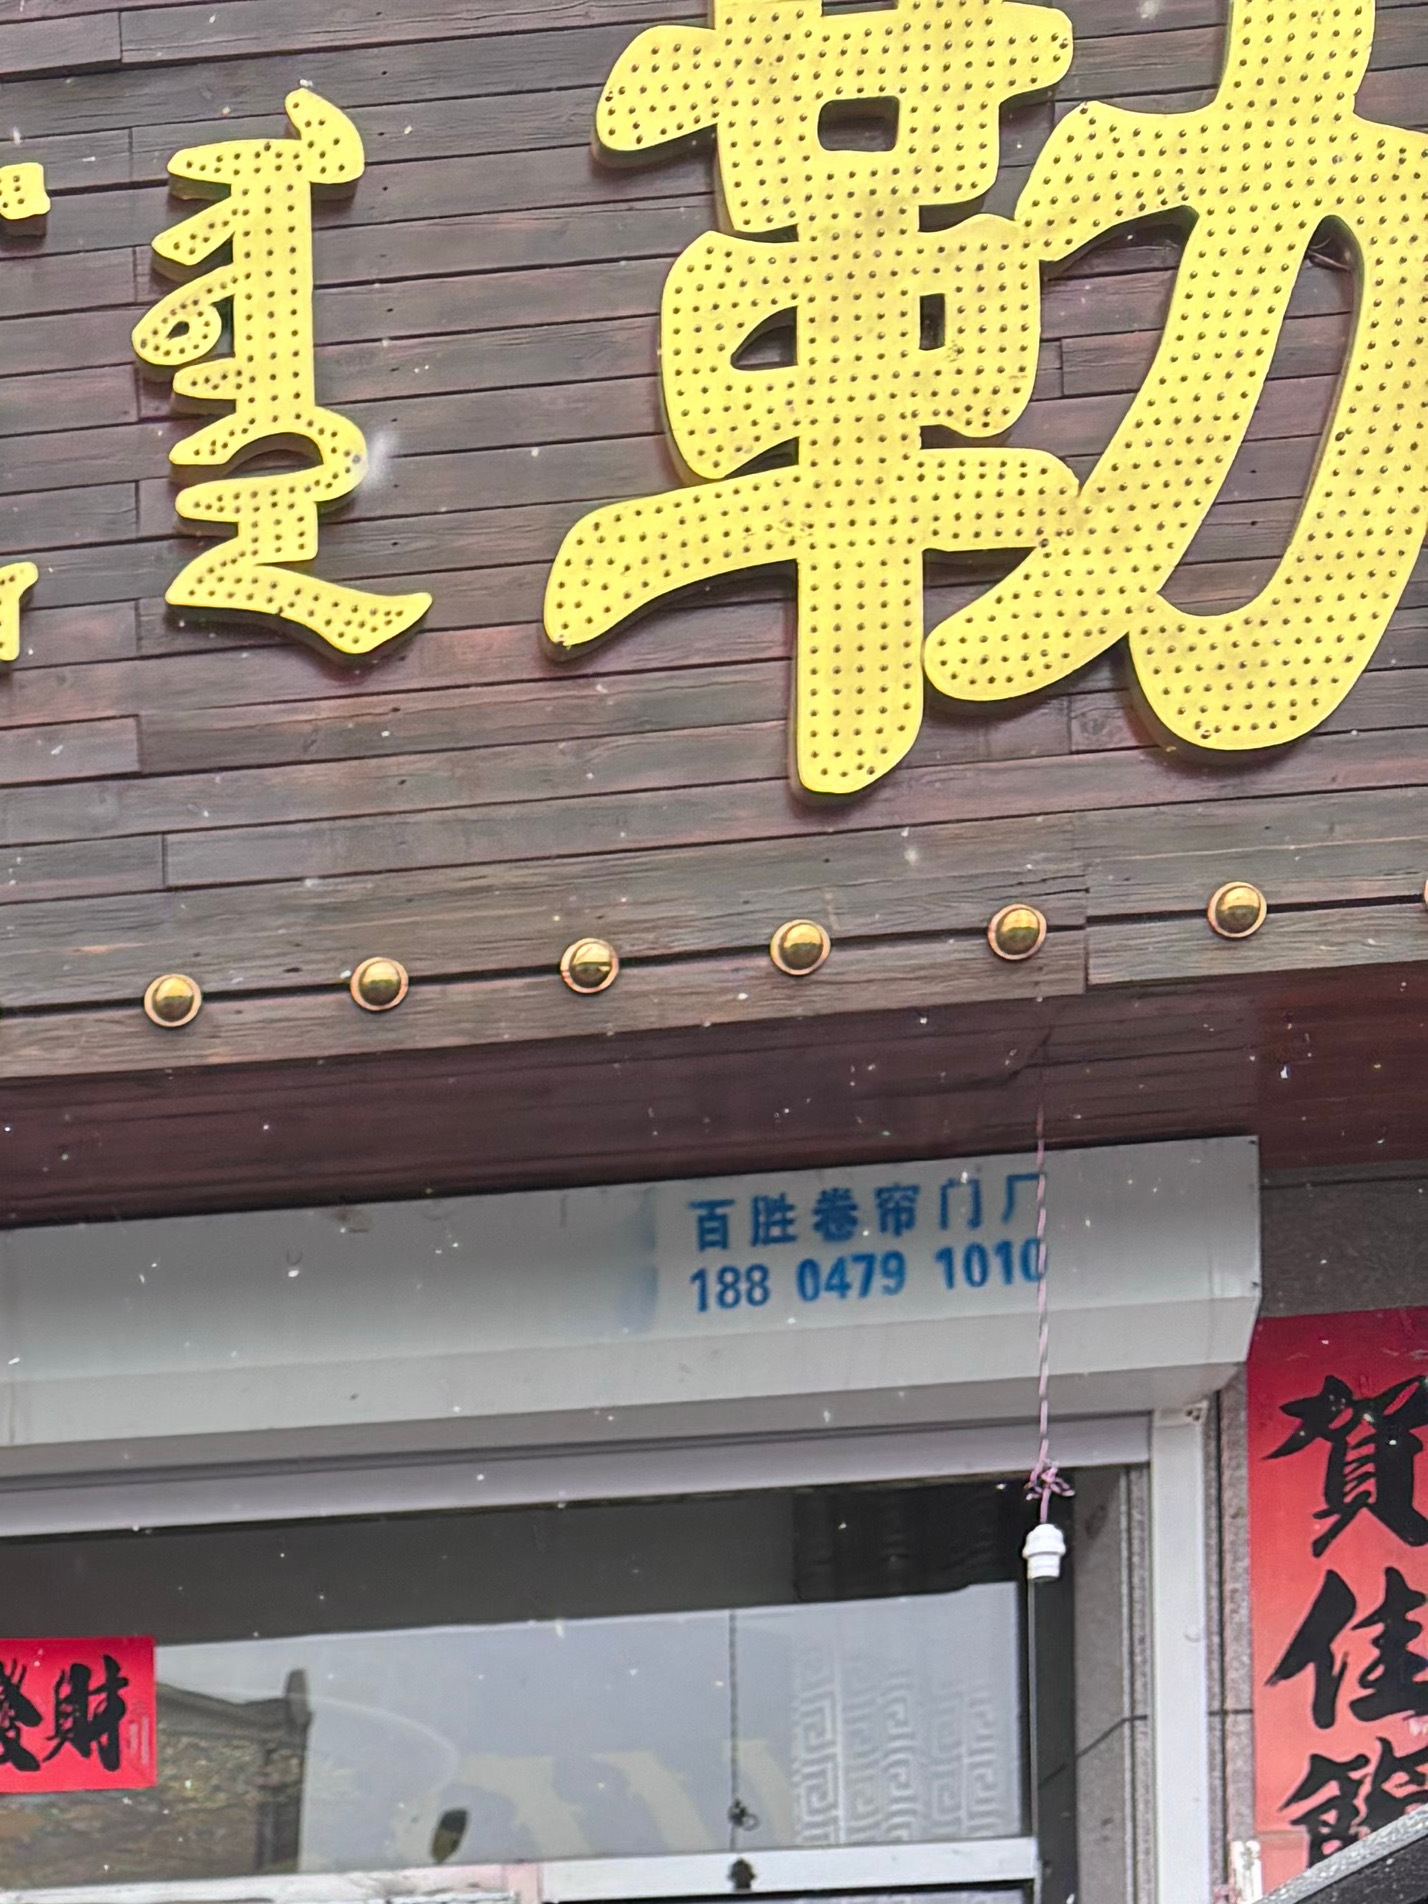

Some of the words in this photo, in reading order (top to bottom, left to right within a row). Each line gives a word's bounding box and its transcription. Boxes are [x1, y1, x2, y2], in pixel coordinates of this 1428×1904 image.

[544, 0, 1428, 794] 勒
[688, 1171, 1046, 1253] 百胜卷帘门厂
[689, 1263, 772, 1313] 188
[795, 1250, 907, 1302] 0479
[935, 1237, 1046, 1290] 1010
